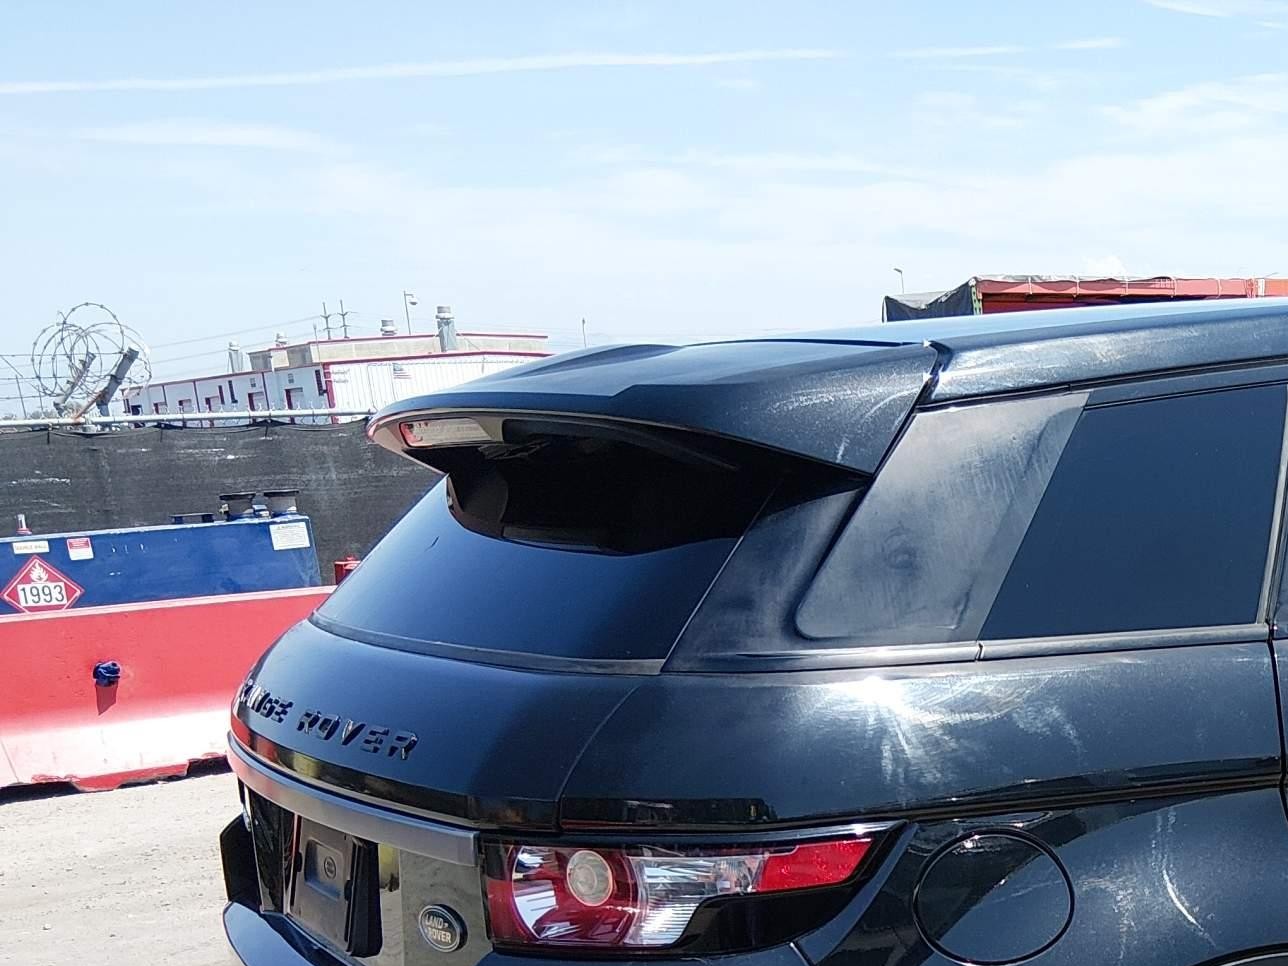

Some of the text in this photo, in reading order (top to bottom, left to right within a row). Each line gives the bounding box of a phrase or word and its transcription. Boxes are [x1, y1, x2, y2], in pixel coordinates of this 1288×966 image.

[20, 585, 65, 605] 1993
[297, 710, 420, 761] ROVER
[425, 914, 444, 929] LAND
[427, 926, 452, 944] ROVER
